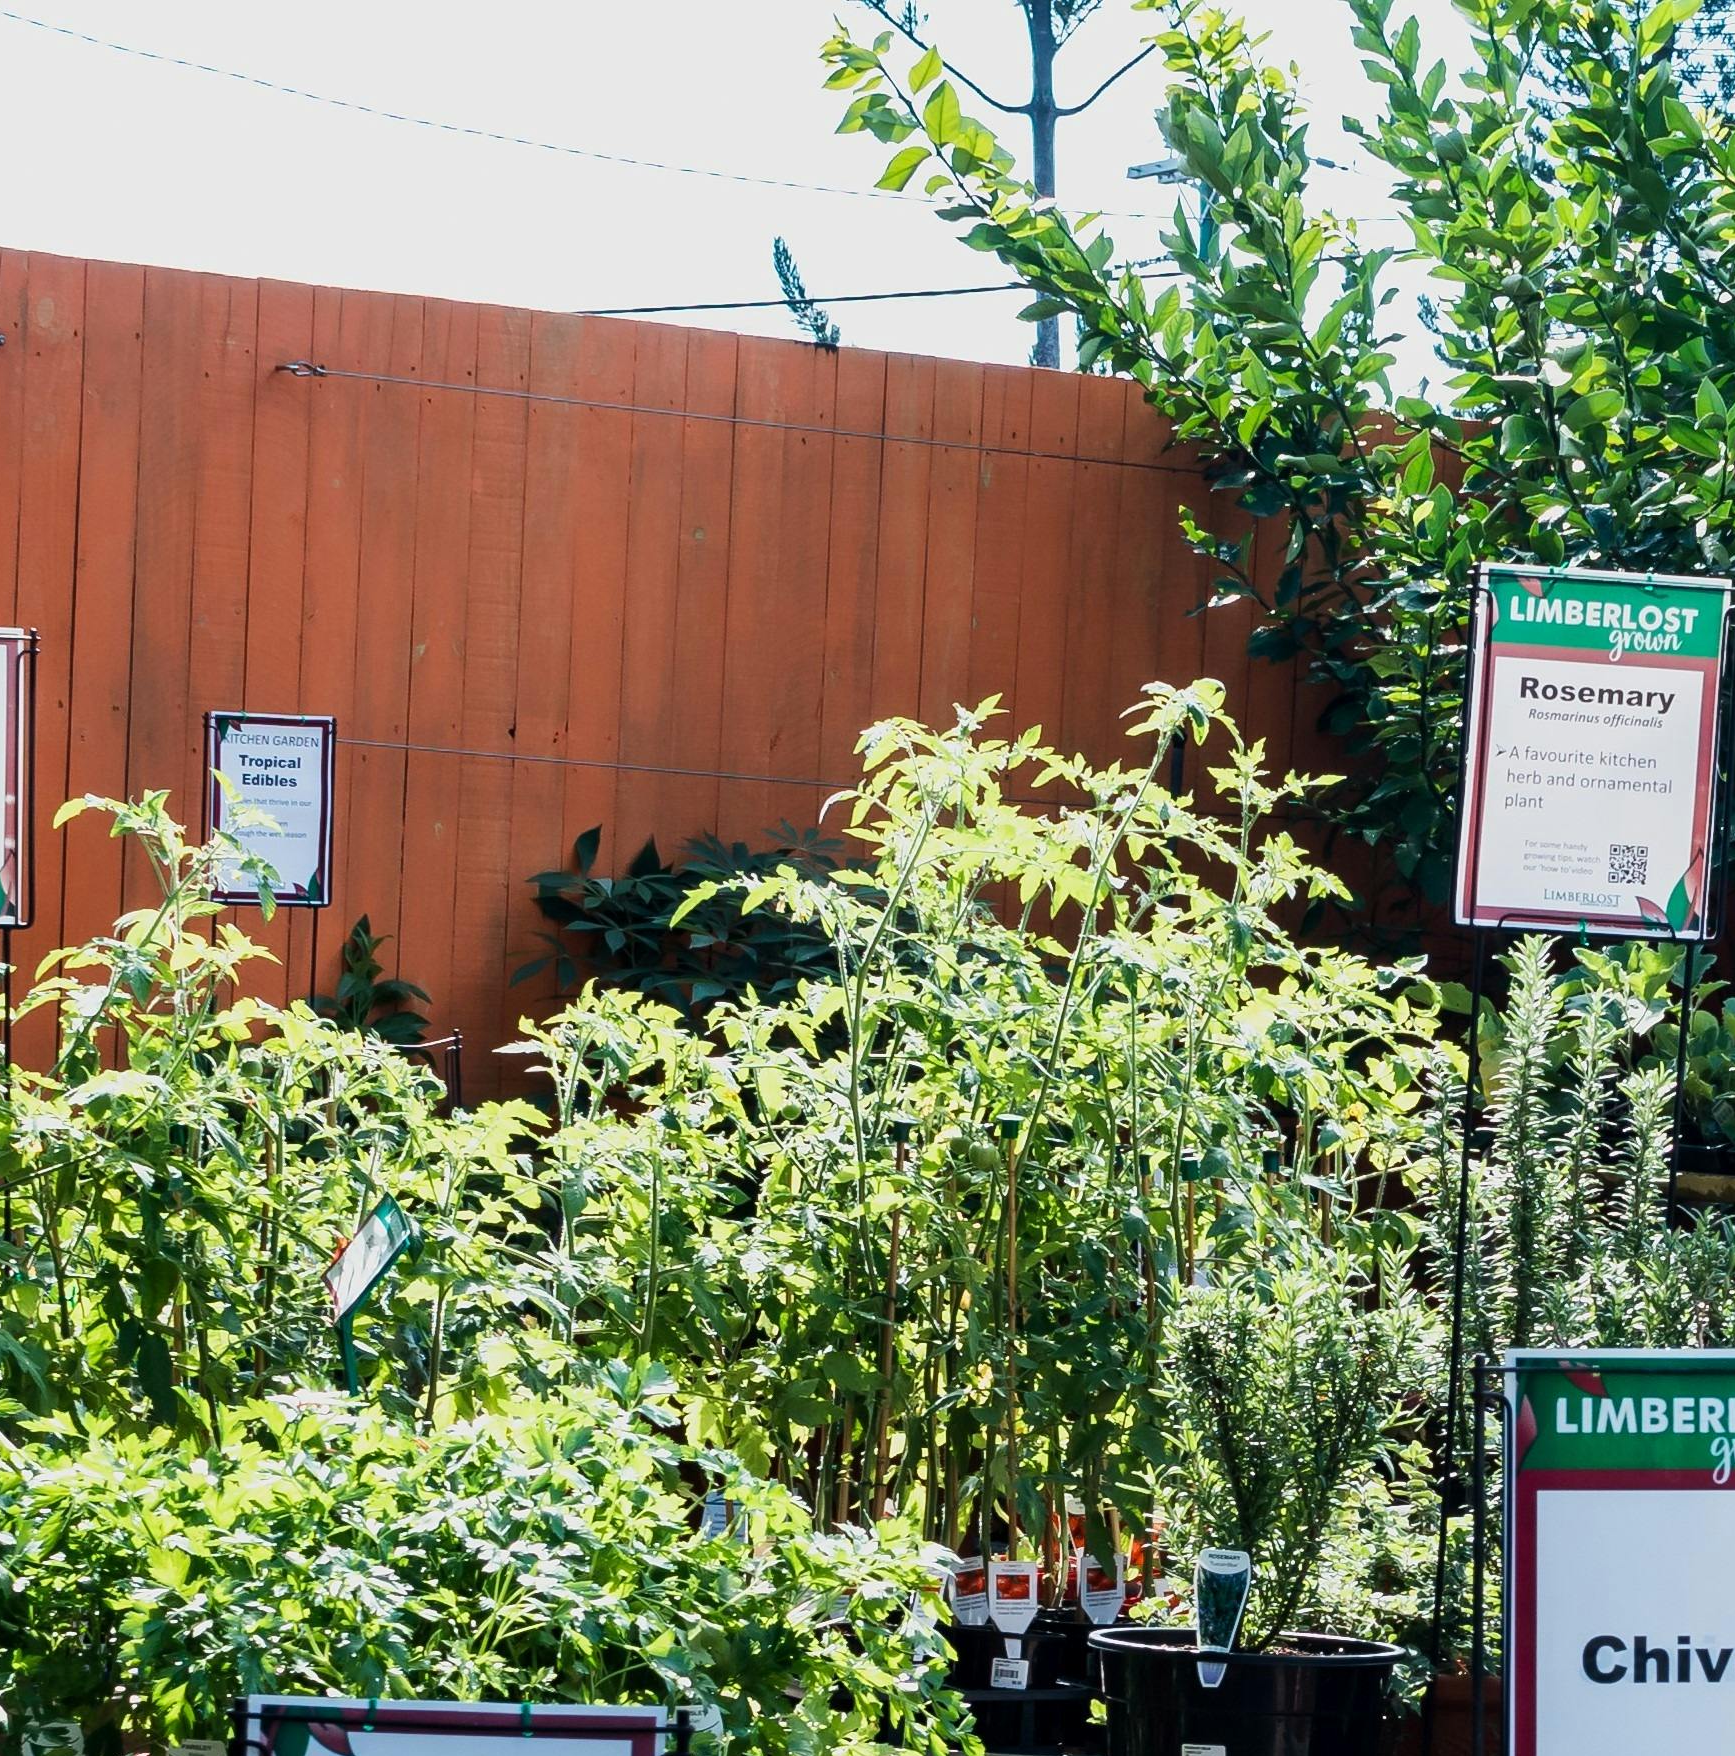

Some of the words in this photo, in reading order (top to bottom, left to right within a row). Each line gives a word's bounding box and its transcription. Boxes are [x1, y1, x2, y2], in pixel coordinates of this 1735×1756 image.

[1509, 596, 1699, 634] LIMBERLOST
[1608, 628, 1682, 662] grown
[1520, 676, 1675, 714] Rosemary
[1528, 708, 1599, 724] Rosmarinus
[1603, 712, 1663, 728] officinalis
[223, 733, 270, 744] KITCHEN
[273, 736, 318, 746] GARDEN
[239, 755, 300, 768] Tropical
[1509, 746, 1519, 759] A
[1524, 746, 1593, 764] favourite
[1599, 751, 1656, 768] kitchen
[242, 774, 297, 786] Edibles
[1506, 770, 1541, 785] herb
[1546, 772, 1574, 787] and
[1580, 776, 1672, 794] ornamental
[1504, 793, 1542, 810] plant
[1543, 888, 1621, 905] LIMBERLOST
